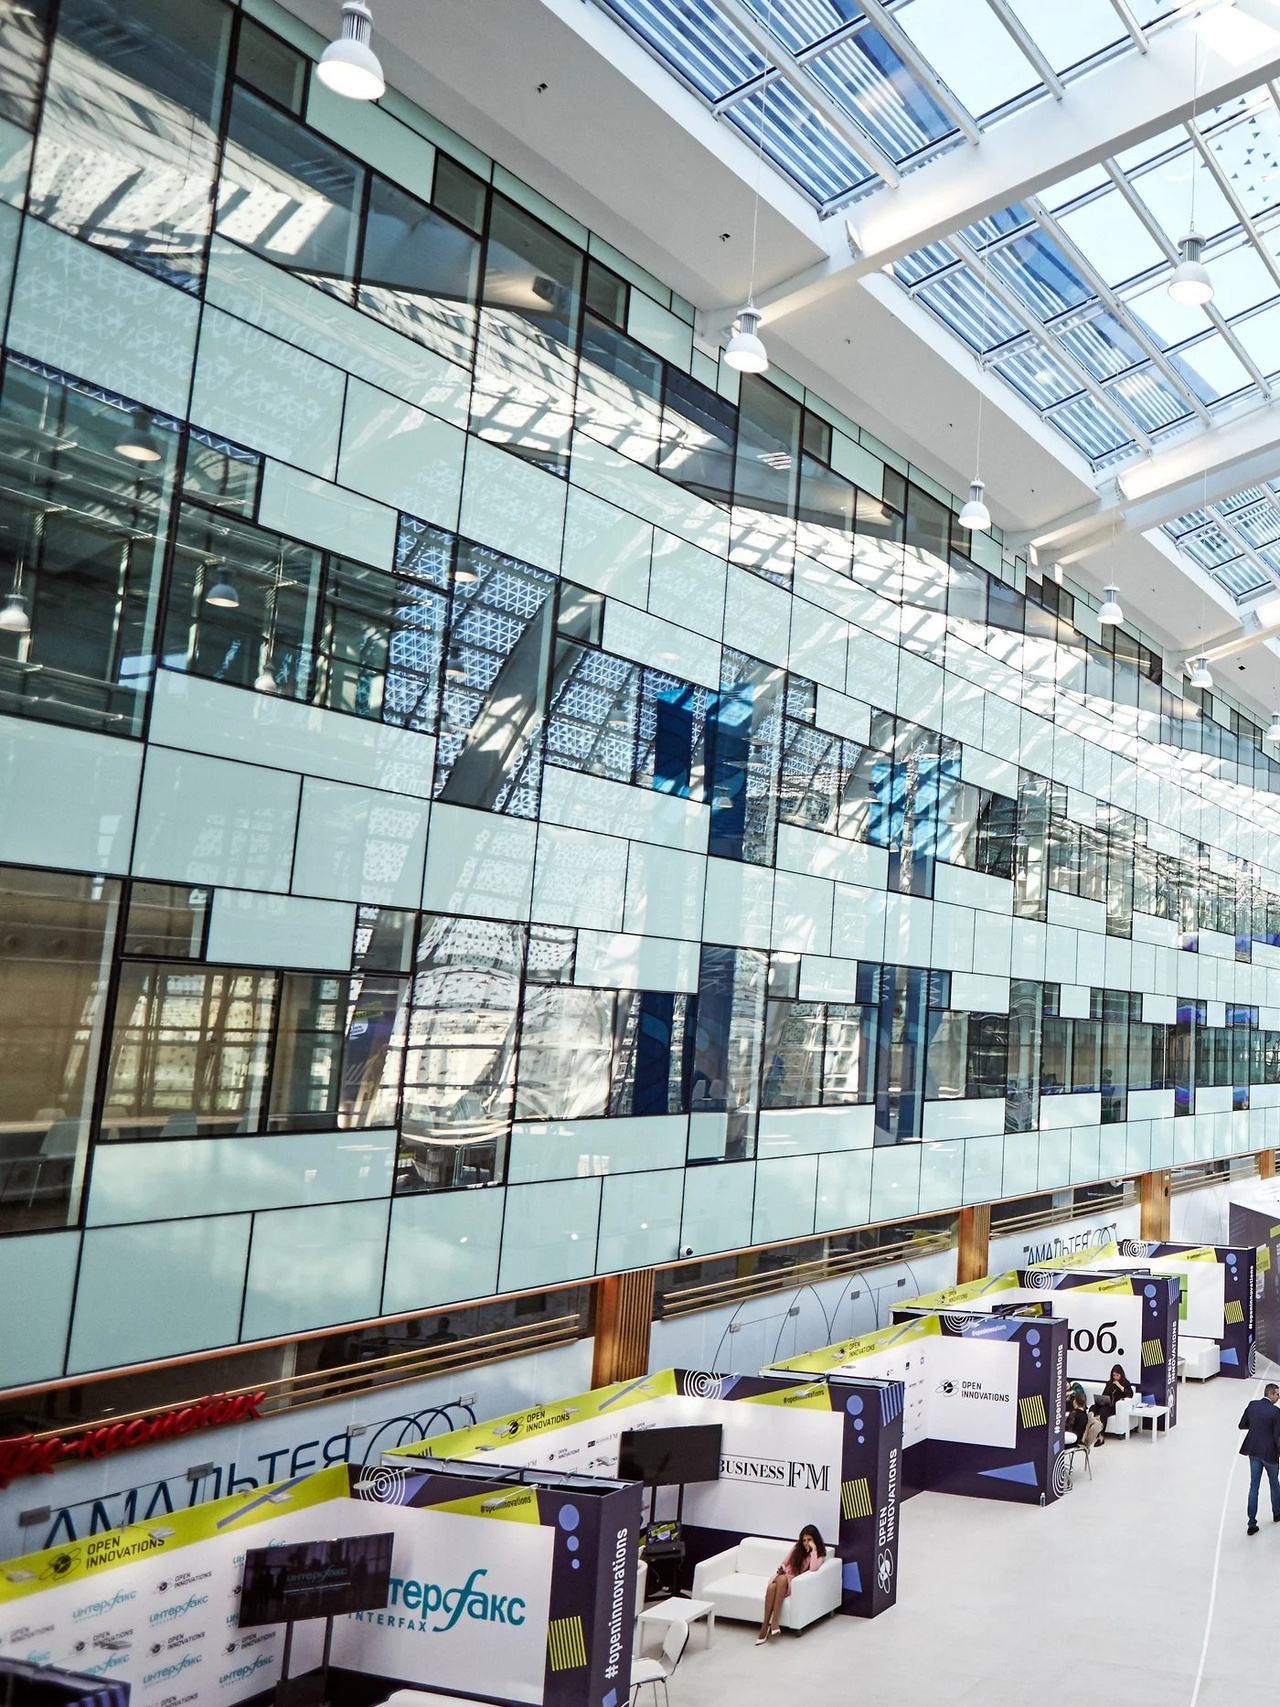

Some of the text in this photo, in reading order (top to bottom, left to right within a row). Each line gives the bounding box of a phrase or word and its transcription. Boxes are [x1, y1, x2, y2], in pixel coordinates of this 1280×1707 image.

[1067, 1321, 1125, 1356] об.
[961, 1390, 1010, 1402] INNOVATIONS
[962, 1381, 982, 1390] OPEN
[1054, 1344, 1064, 1435] #openinnovations
[526, 1413, 570, 1433] INNOVATIONS
[527, 1410, 546, 1423] OPEN
[719, 1459, 831, 1492] BUSINESS FM
[887, 1449, 898, 1542] INNOVATIONS
[879, 1506, 888, 1547] OPEN
[86, 1539, 166, 1569] INNOVATIONS
[87, 1536, 121, 1556] OPEN
[174, 1572, 192, 1583] OPEN
[174, 1571, 212, 1589] INNOVATIONS
[73, 1588, 137, 1619] интерфакс
[150, 1594, 209, 1623] интерфакс
[388, 1568, 526, 1632] терфакс
[605, 1528, 628, 1680] #openinnovations
[167, 1633, 185, 1644] OPEN
[167, 1631, 206, 1650] INNOVATIONS
[143, 1653, 203, 1684] интерфакс
[219, 1653, 274, 1684] интерфакс
